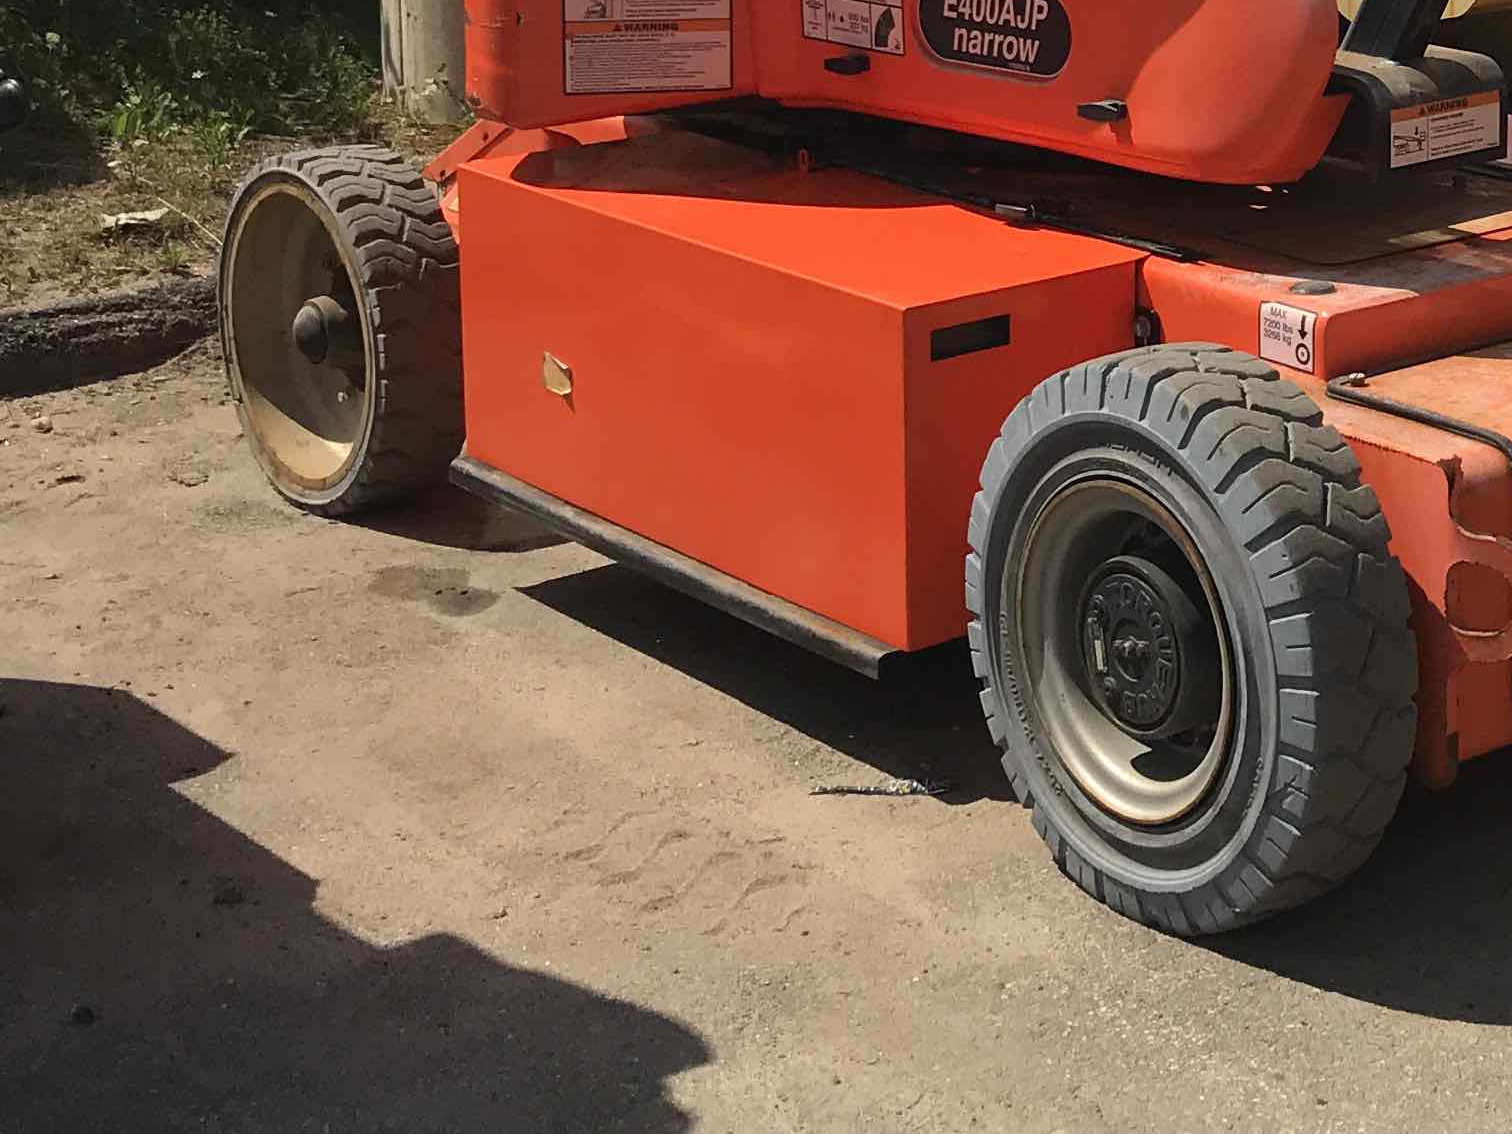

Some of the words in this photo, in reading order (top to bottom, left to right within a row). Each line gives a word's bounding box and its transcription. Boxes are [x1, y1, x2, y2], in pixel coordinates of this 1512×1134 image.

[623, 23, 680, 33] WARNING
[953, 26, 1041, 64] narrow
[1270, 306, 1288, 318] MAX
